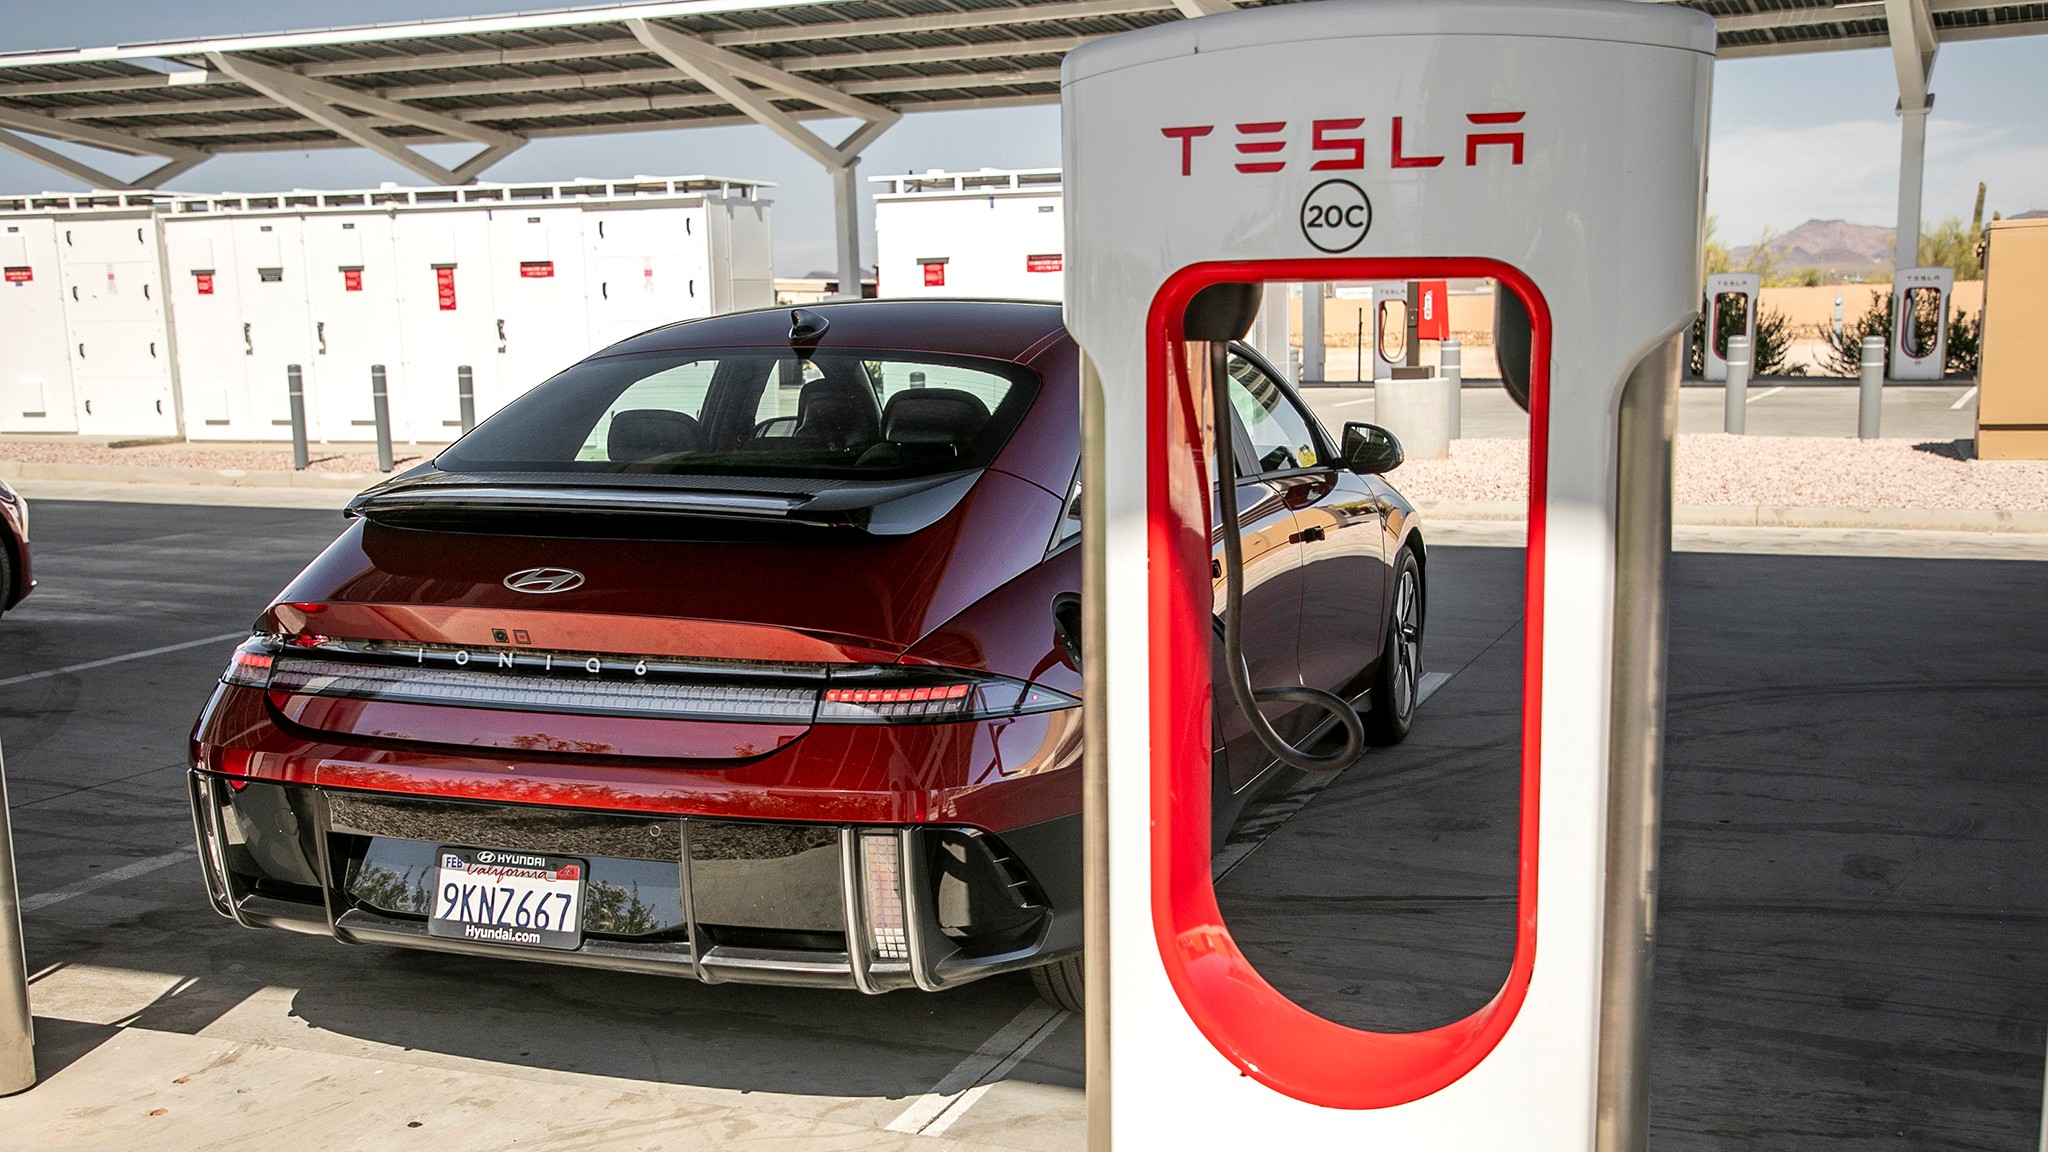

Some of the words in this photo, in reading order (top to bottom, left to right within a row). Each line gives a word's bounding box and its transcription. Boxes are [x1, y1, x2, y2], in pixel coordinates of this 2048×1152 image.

[1160, 111, 1526, 176] TESLA
[1306, 205, 1365, 228] 20C
[417, 648, 601, 674] IONIQ
[634, 660, 647, 676] 6
[446, 856, 463, 868] FEB
[497, 854, 546, 867] HYUNDAI
[466, 863, 557, 883] California
[442, 882, 572, 932] 9KNZ667
[464, 924, 541, 944] Hyundai.com
